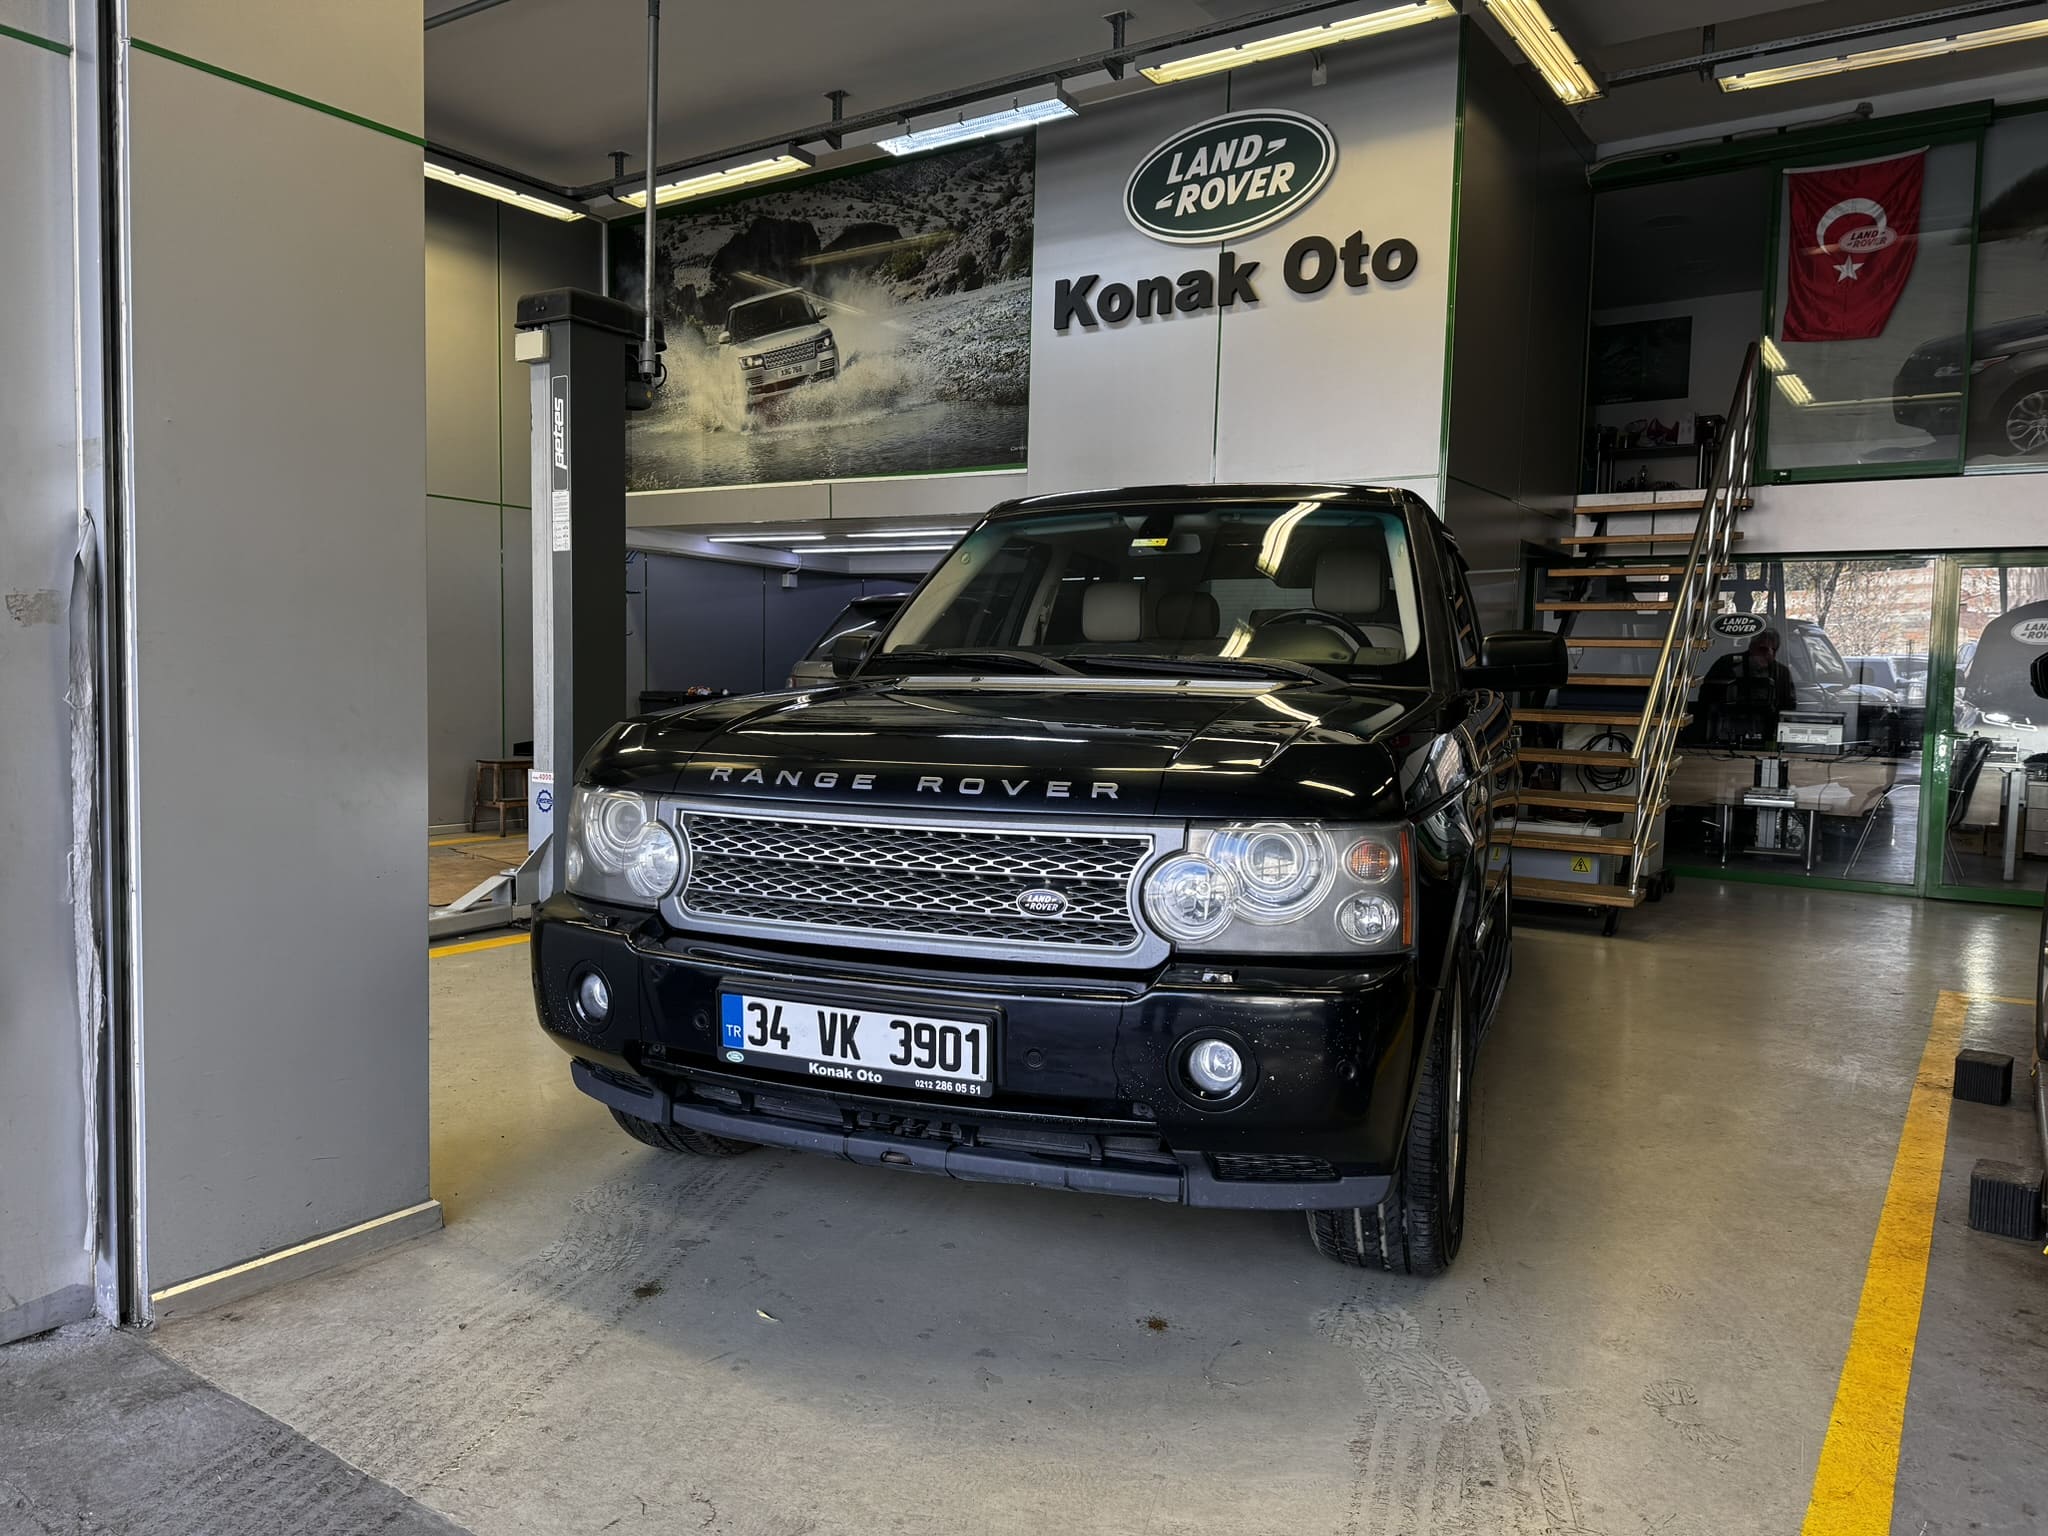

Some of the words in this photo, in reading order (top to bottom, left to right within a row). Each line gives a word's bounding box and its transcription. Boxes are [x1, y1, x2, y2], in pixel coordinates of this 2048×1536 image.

[1166, 134, 1263, 185] LAND
[1174, 161, 1296, 217] ROVER
[1850, 230, 1879, 241] LAND
[1054, 251, 1260, 330] Konak
[1284, 230, 1418, 294] Oto
[1723, 617, 1749, 625] LAND
[1724, 624, 1757, 632] ROVER
[2024, 623, 2048, 631] LAN
[710, 768, 876, 790] RANGE
[917, 776, 1119, 799] ROVER
[1026, 894, 1052, 903] LAND
[1029, 902, 1059, 911] ROVER
[726, 1024, 741, 1038] TR
[747, 1002, 790, 1049] 34
[817, 1010, 861, 1060] VK
[889, 1020, 981, 1075] 3901
[808, 1062, 853, 1080] Konak
[857, 1069, 882, 1084] Oto
[915, 1080, 933, 1089] 0212
[935, 1080, 952, 1091] 286
[955, 1083, 967, 1093] 05
[969, 1085, 981, 1095] 51
